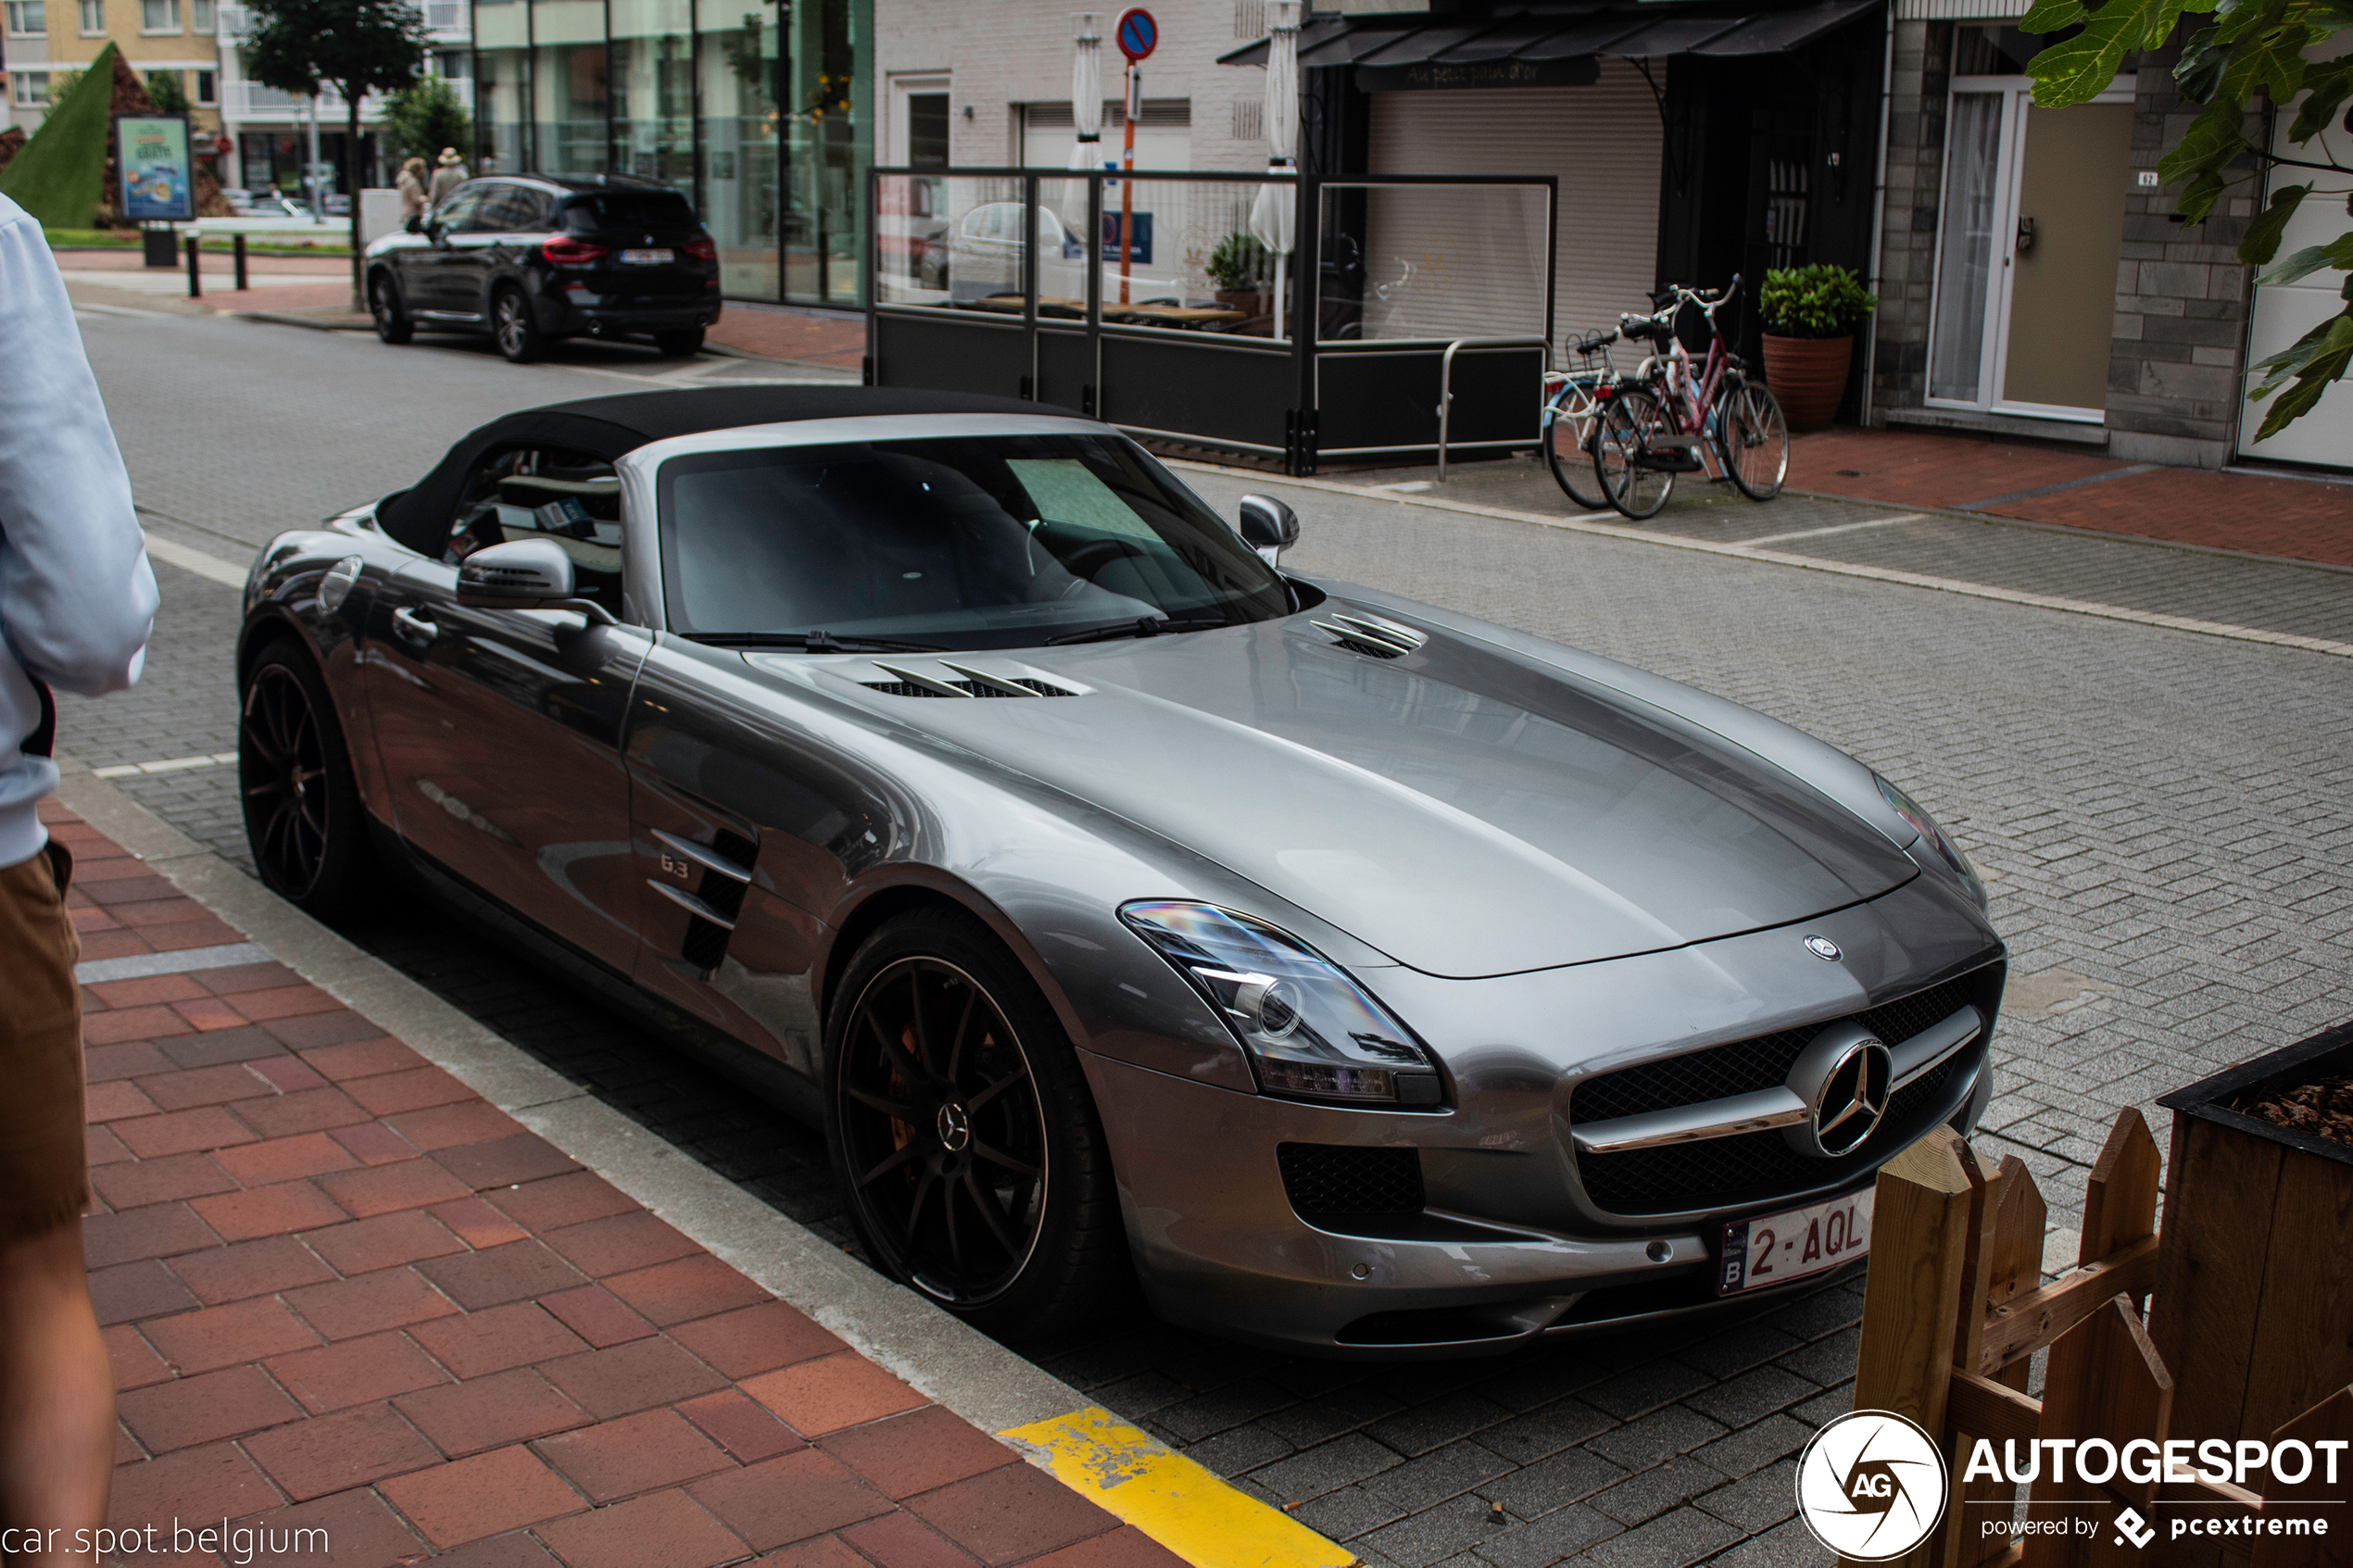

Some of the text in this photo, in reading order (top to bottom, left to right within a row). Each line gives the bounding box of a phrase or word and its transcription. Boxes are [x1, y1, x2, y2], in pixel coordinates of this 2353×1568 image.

[1408, 66, 1429, 82] Au
[1432, 67, 1466, 88] petit
[1471, 65, 1504, 88] pain
[2143, 173, 2154, 184] 62
[1726, 1261, 1741, 1284] B
